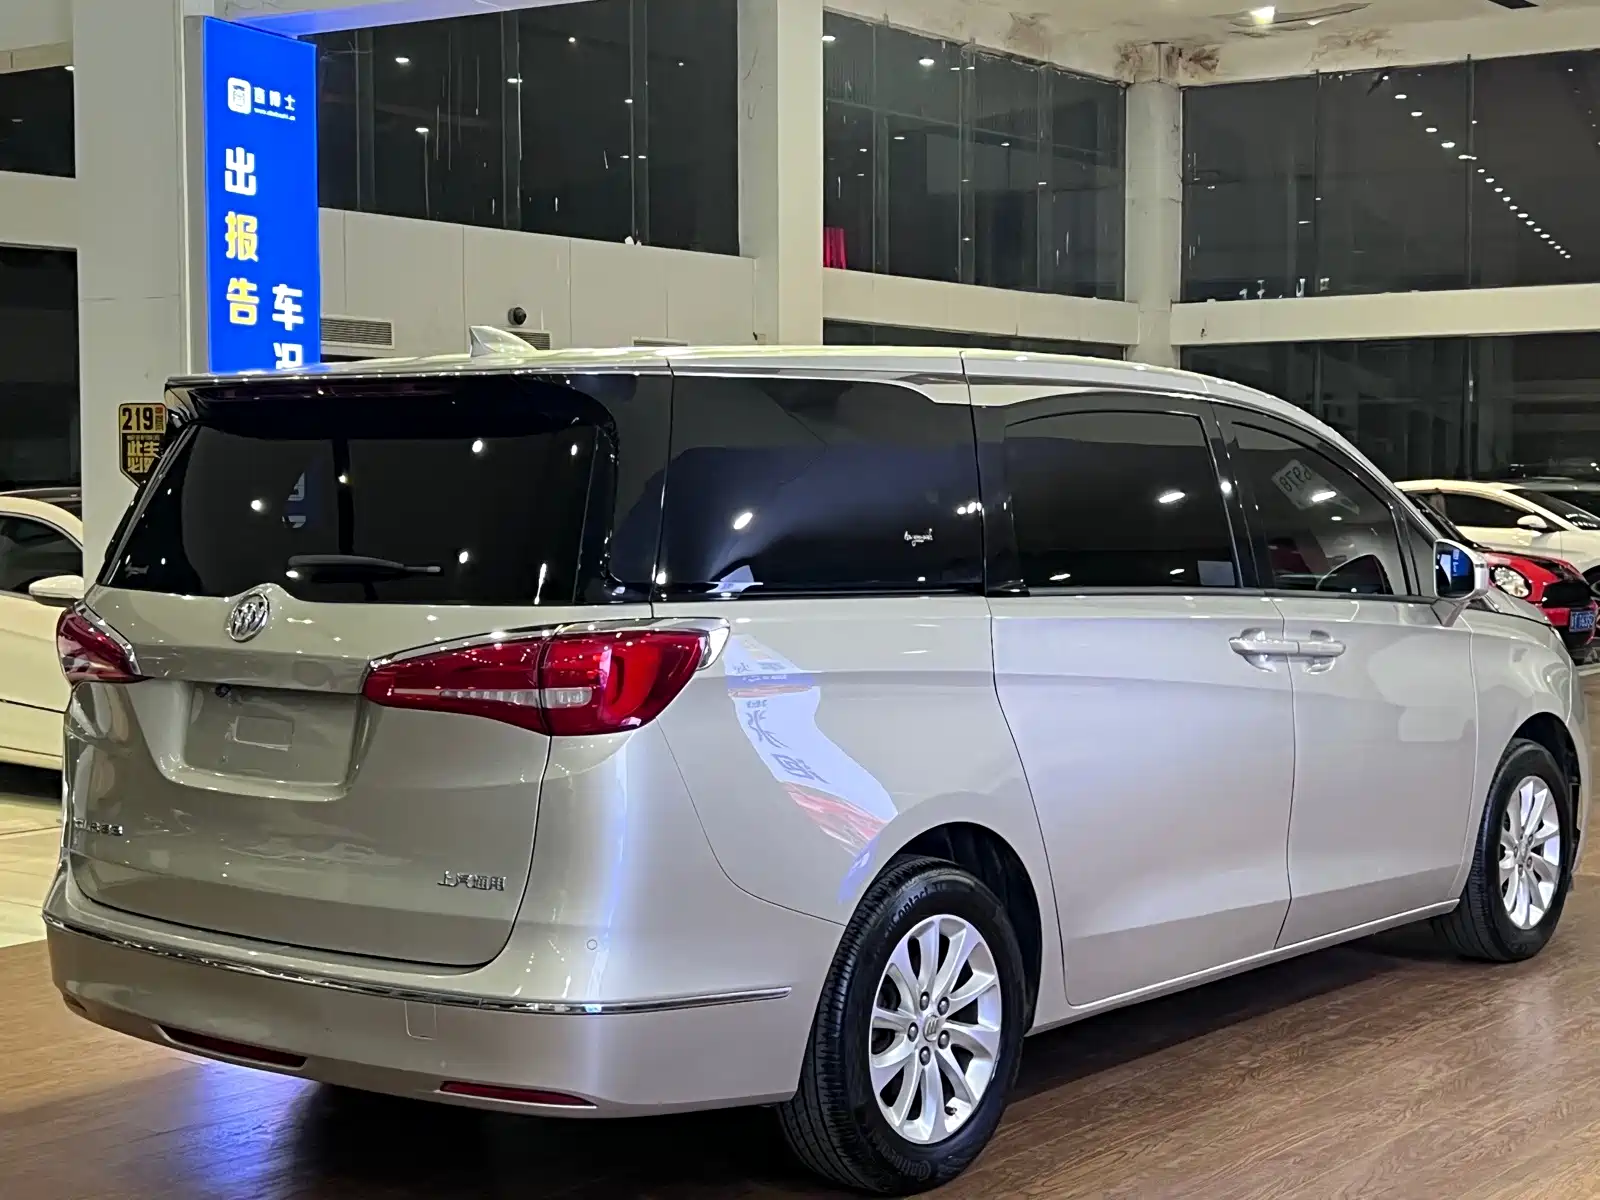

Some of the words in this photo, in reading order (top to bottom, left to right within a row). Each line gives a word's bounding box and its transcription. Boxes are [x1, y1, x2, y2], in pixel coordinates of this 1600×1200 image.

[224, 146, 260, 327] 出报告
[122, 406, 153, 431] 219
